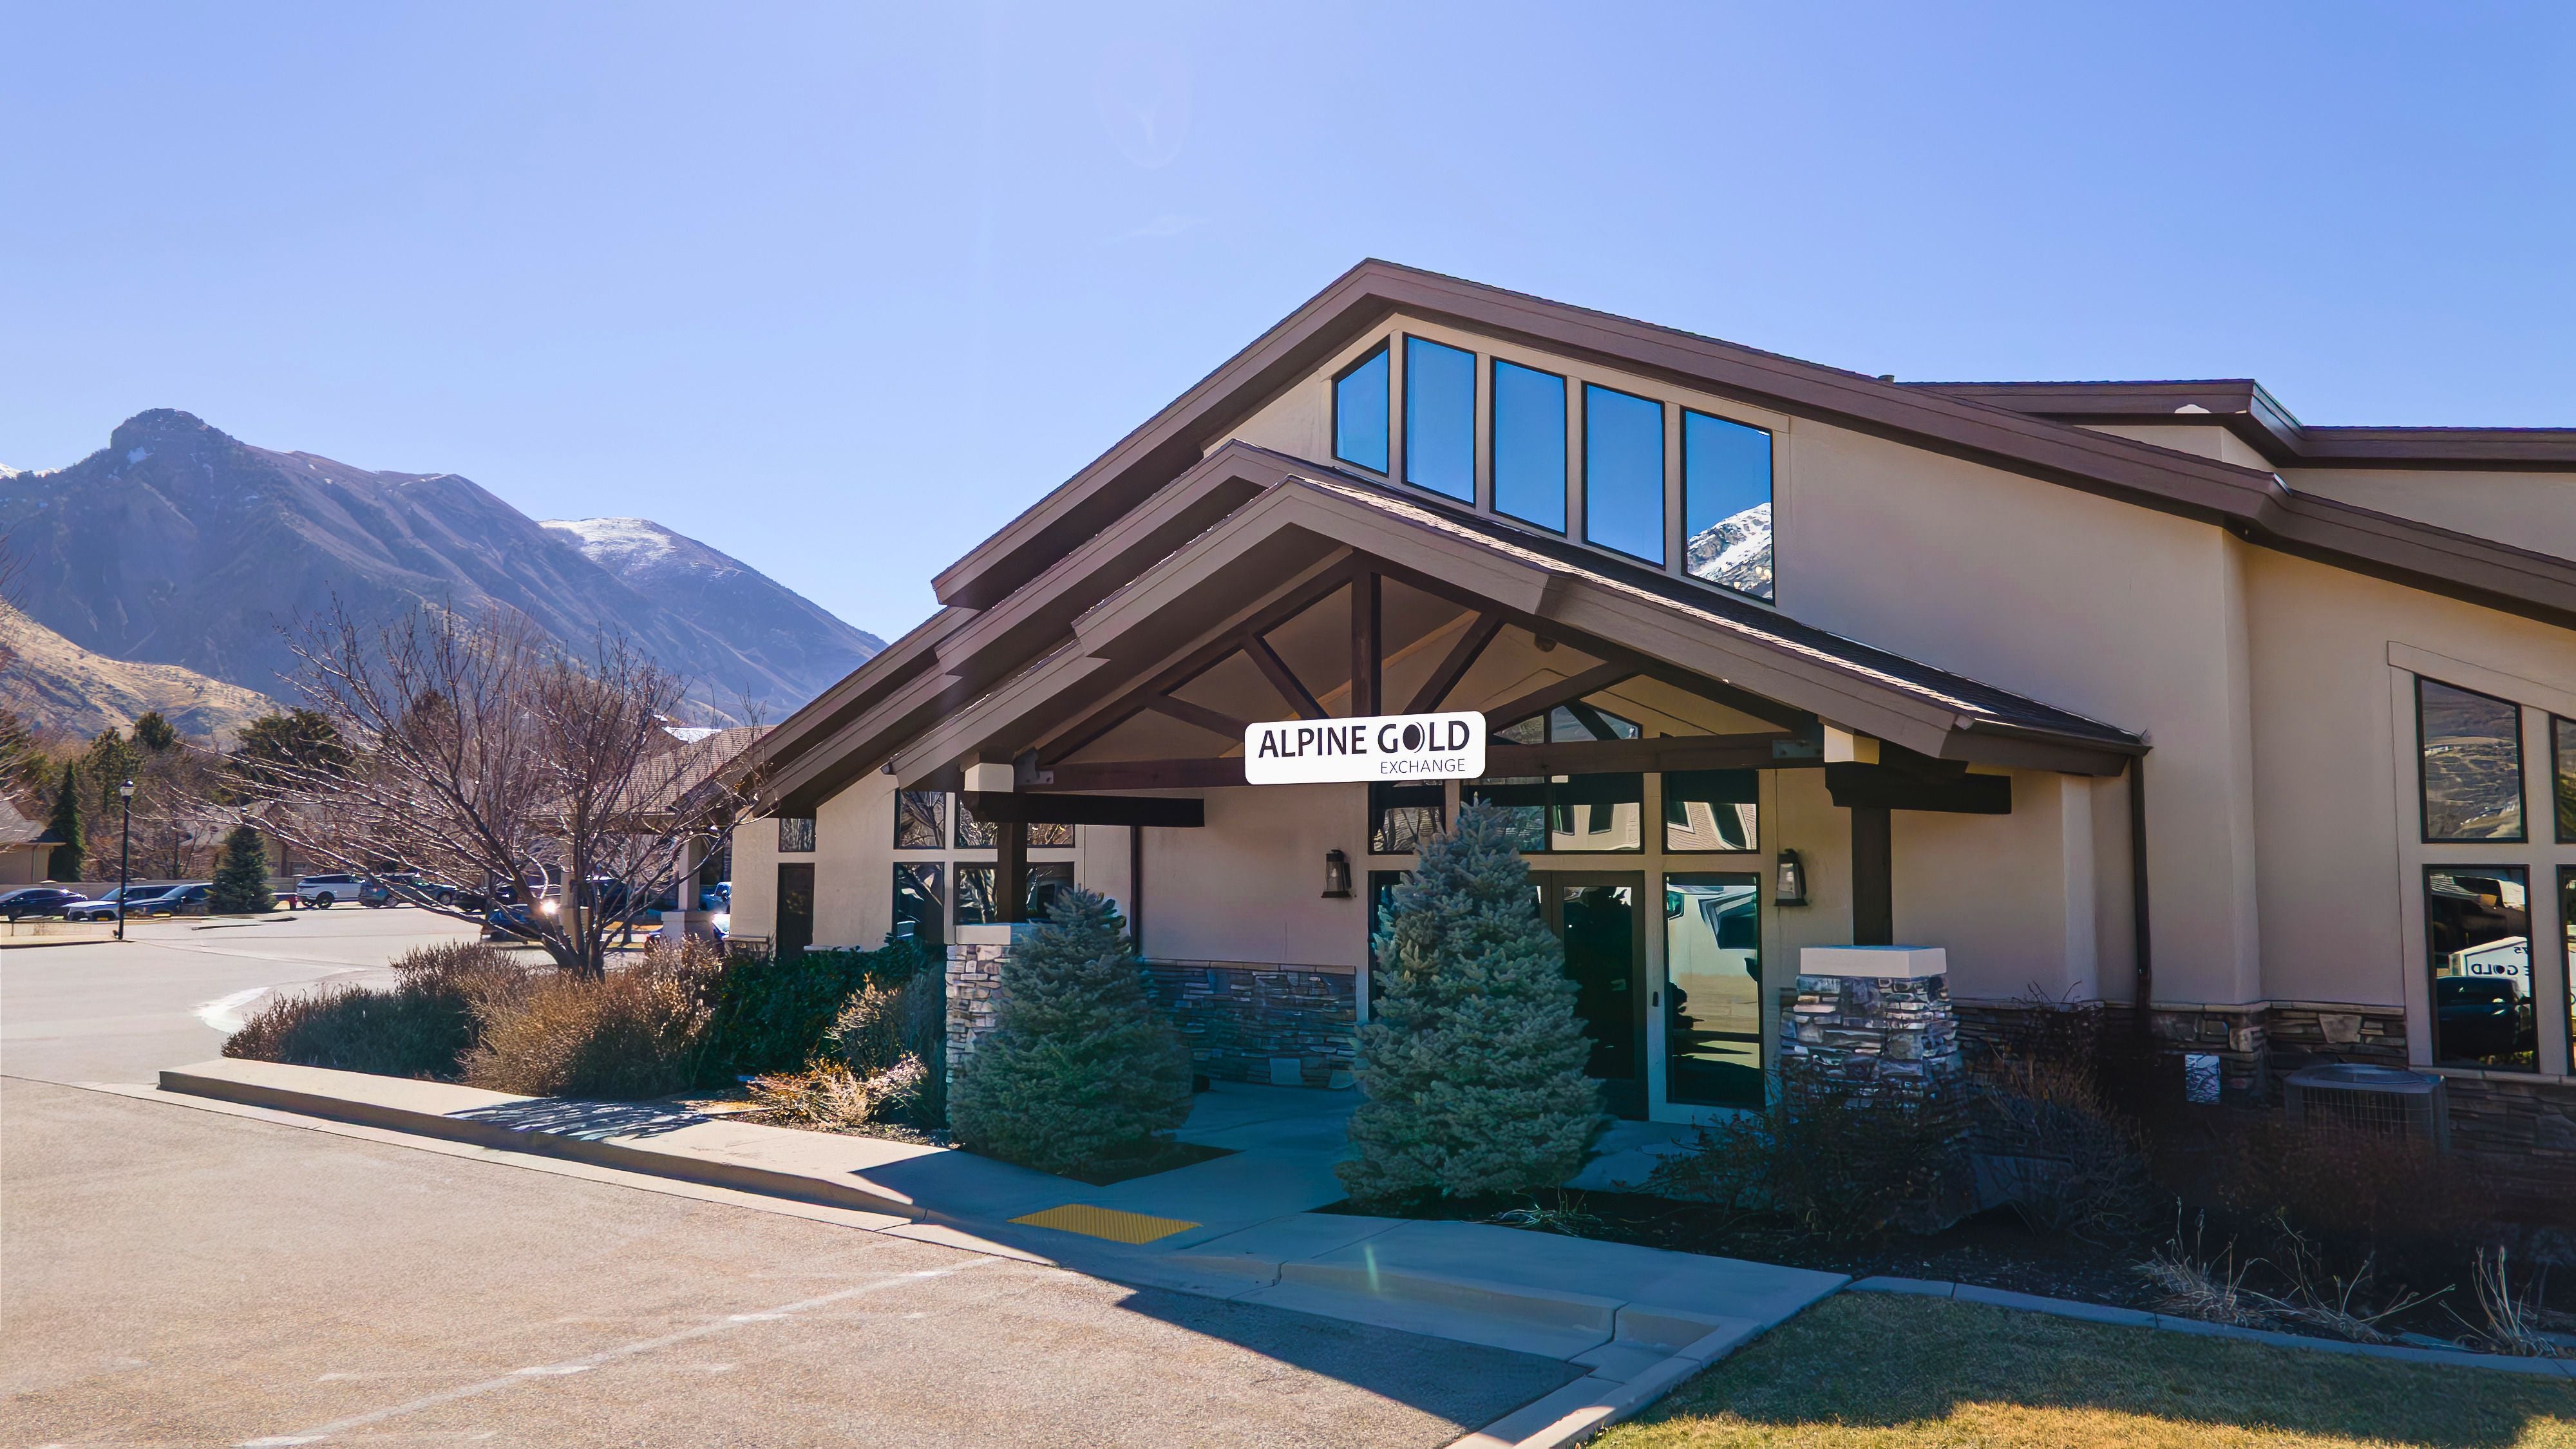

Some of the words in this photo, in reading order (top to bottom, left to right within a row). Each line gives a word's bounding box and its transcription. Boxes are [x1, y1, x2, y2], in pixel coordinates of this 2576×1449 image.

[1258, 725, 1367, 759] ALPINE
[1378, 720, 1470, 753] GOLD
[1381, 758, 1466, 774] EXCHANGE
